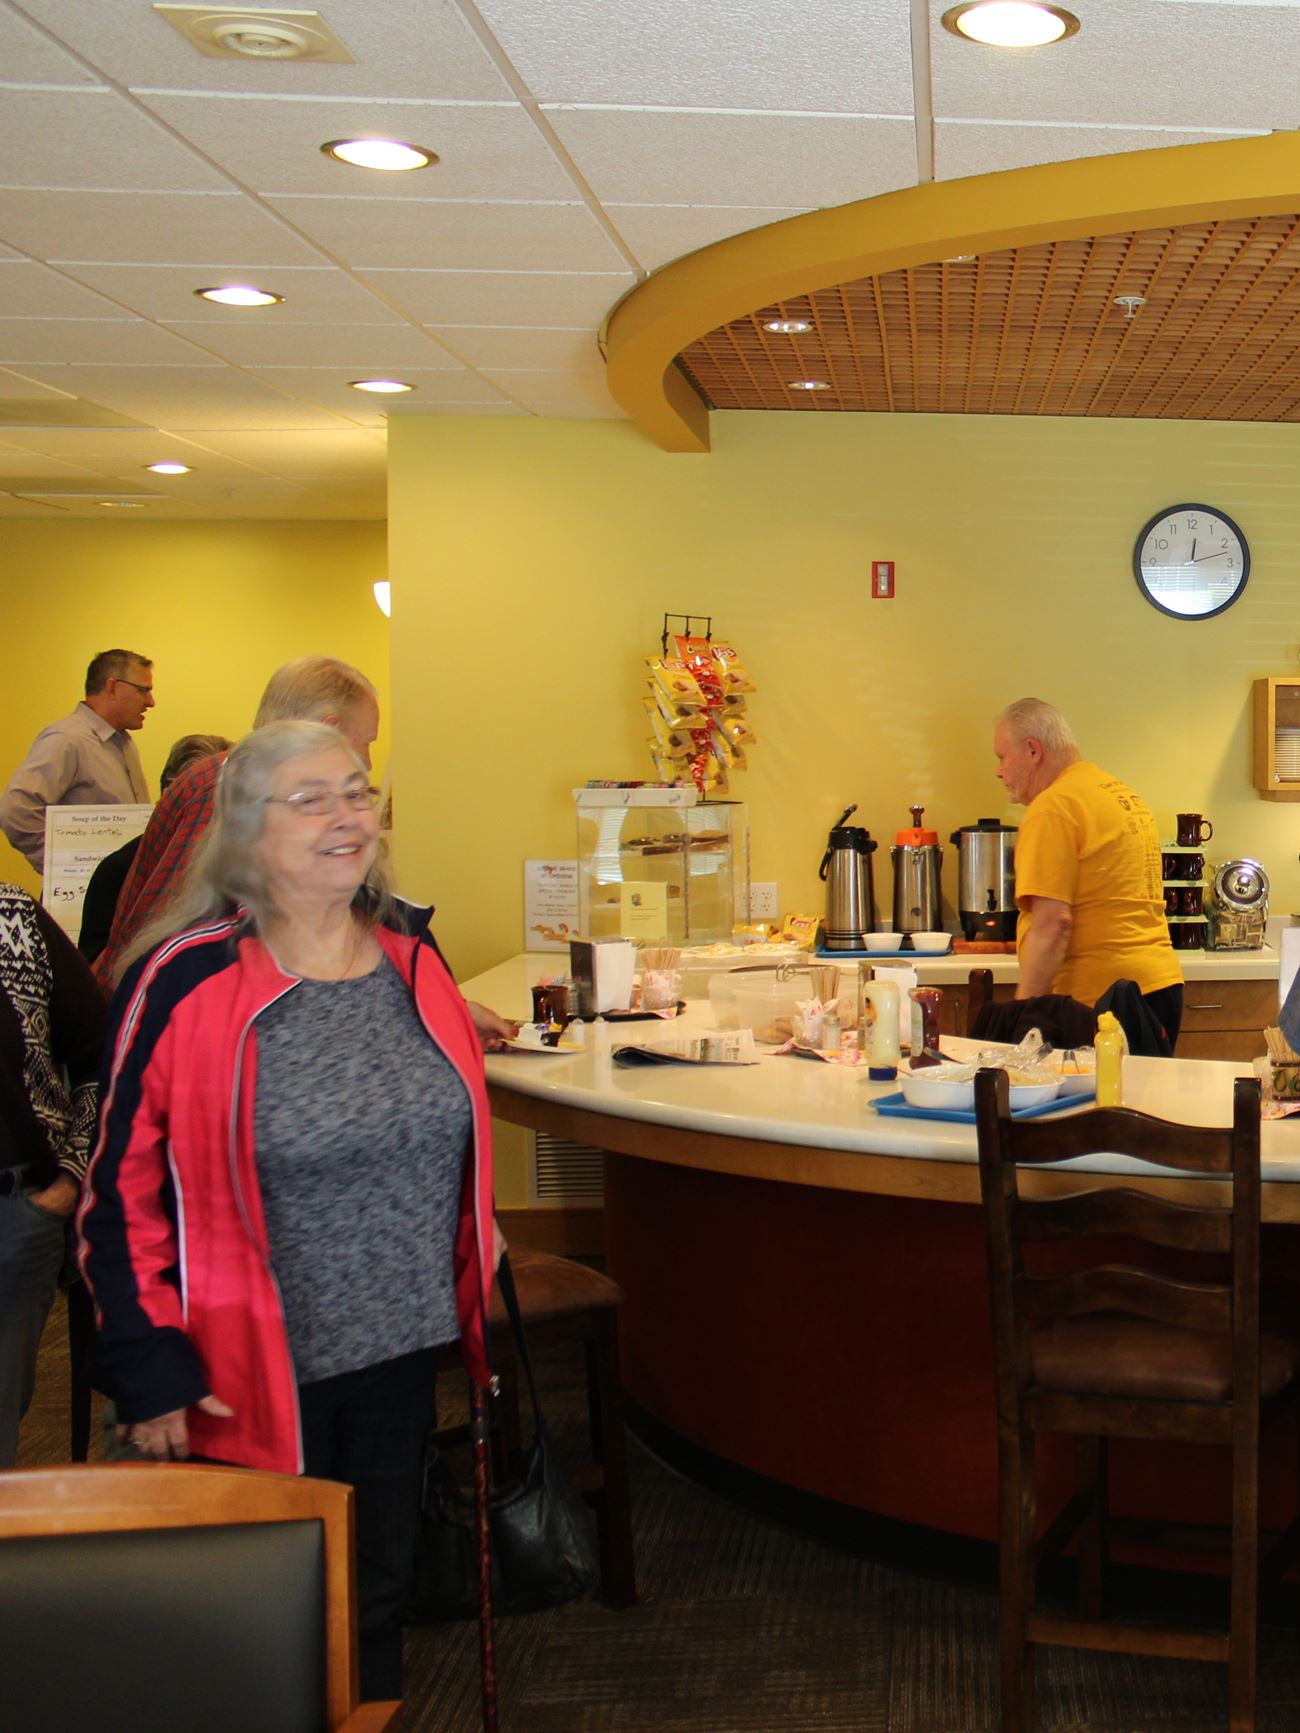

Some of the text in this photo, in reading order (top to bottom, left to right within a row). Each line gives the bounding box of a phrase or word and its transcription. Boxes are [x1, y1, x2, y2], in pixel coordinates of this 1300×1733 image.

[1169, 524, 1177, 535] 11
[1187, 519, 1198, 530] 12
[1209, 524, 1213, 535] 1
[1155, 539, 1169, 550] 10
[1221, 538, 1228, 549] 2
[1149, 557, 1157, 568] 9
[1227, 558, 1233, 568] 3
[113, 815, 127, 823] Day
[54, 886, 75, 902] Egg
